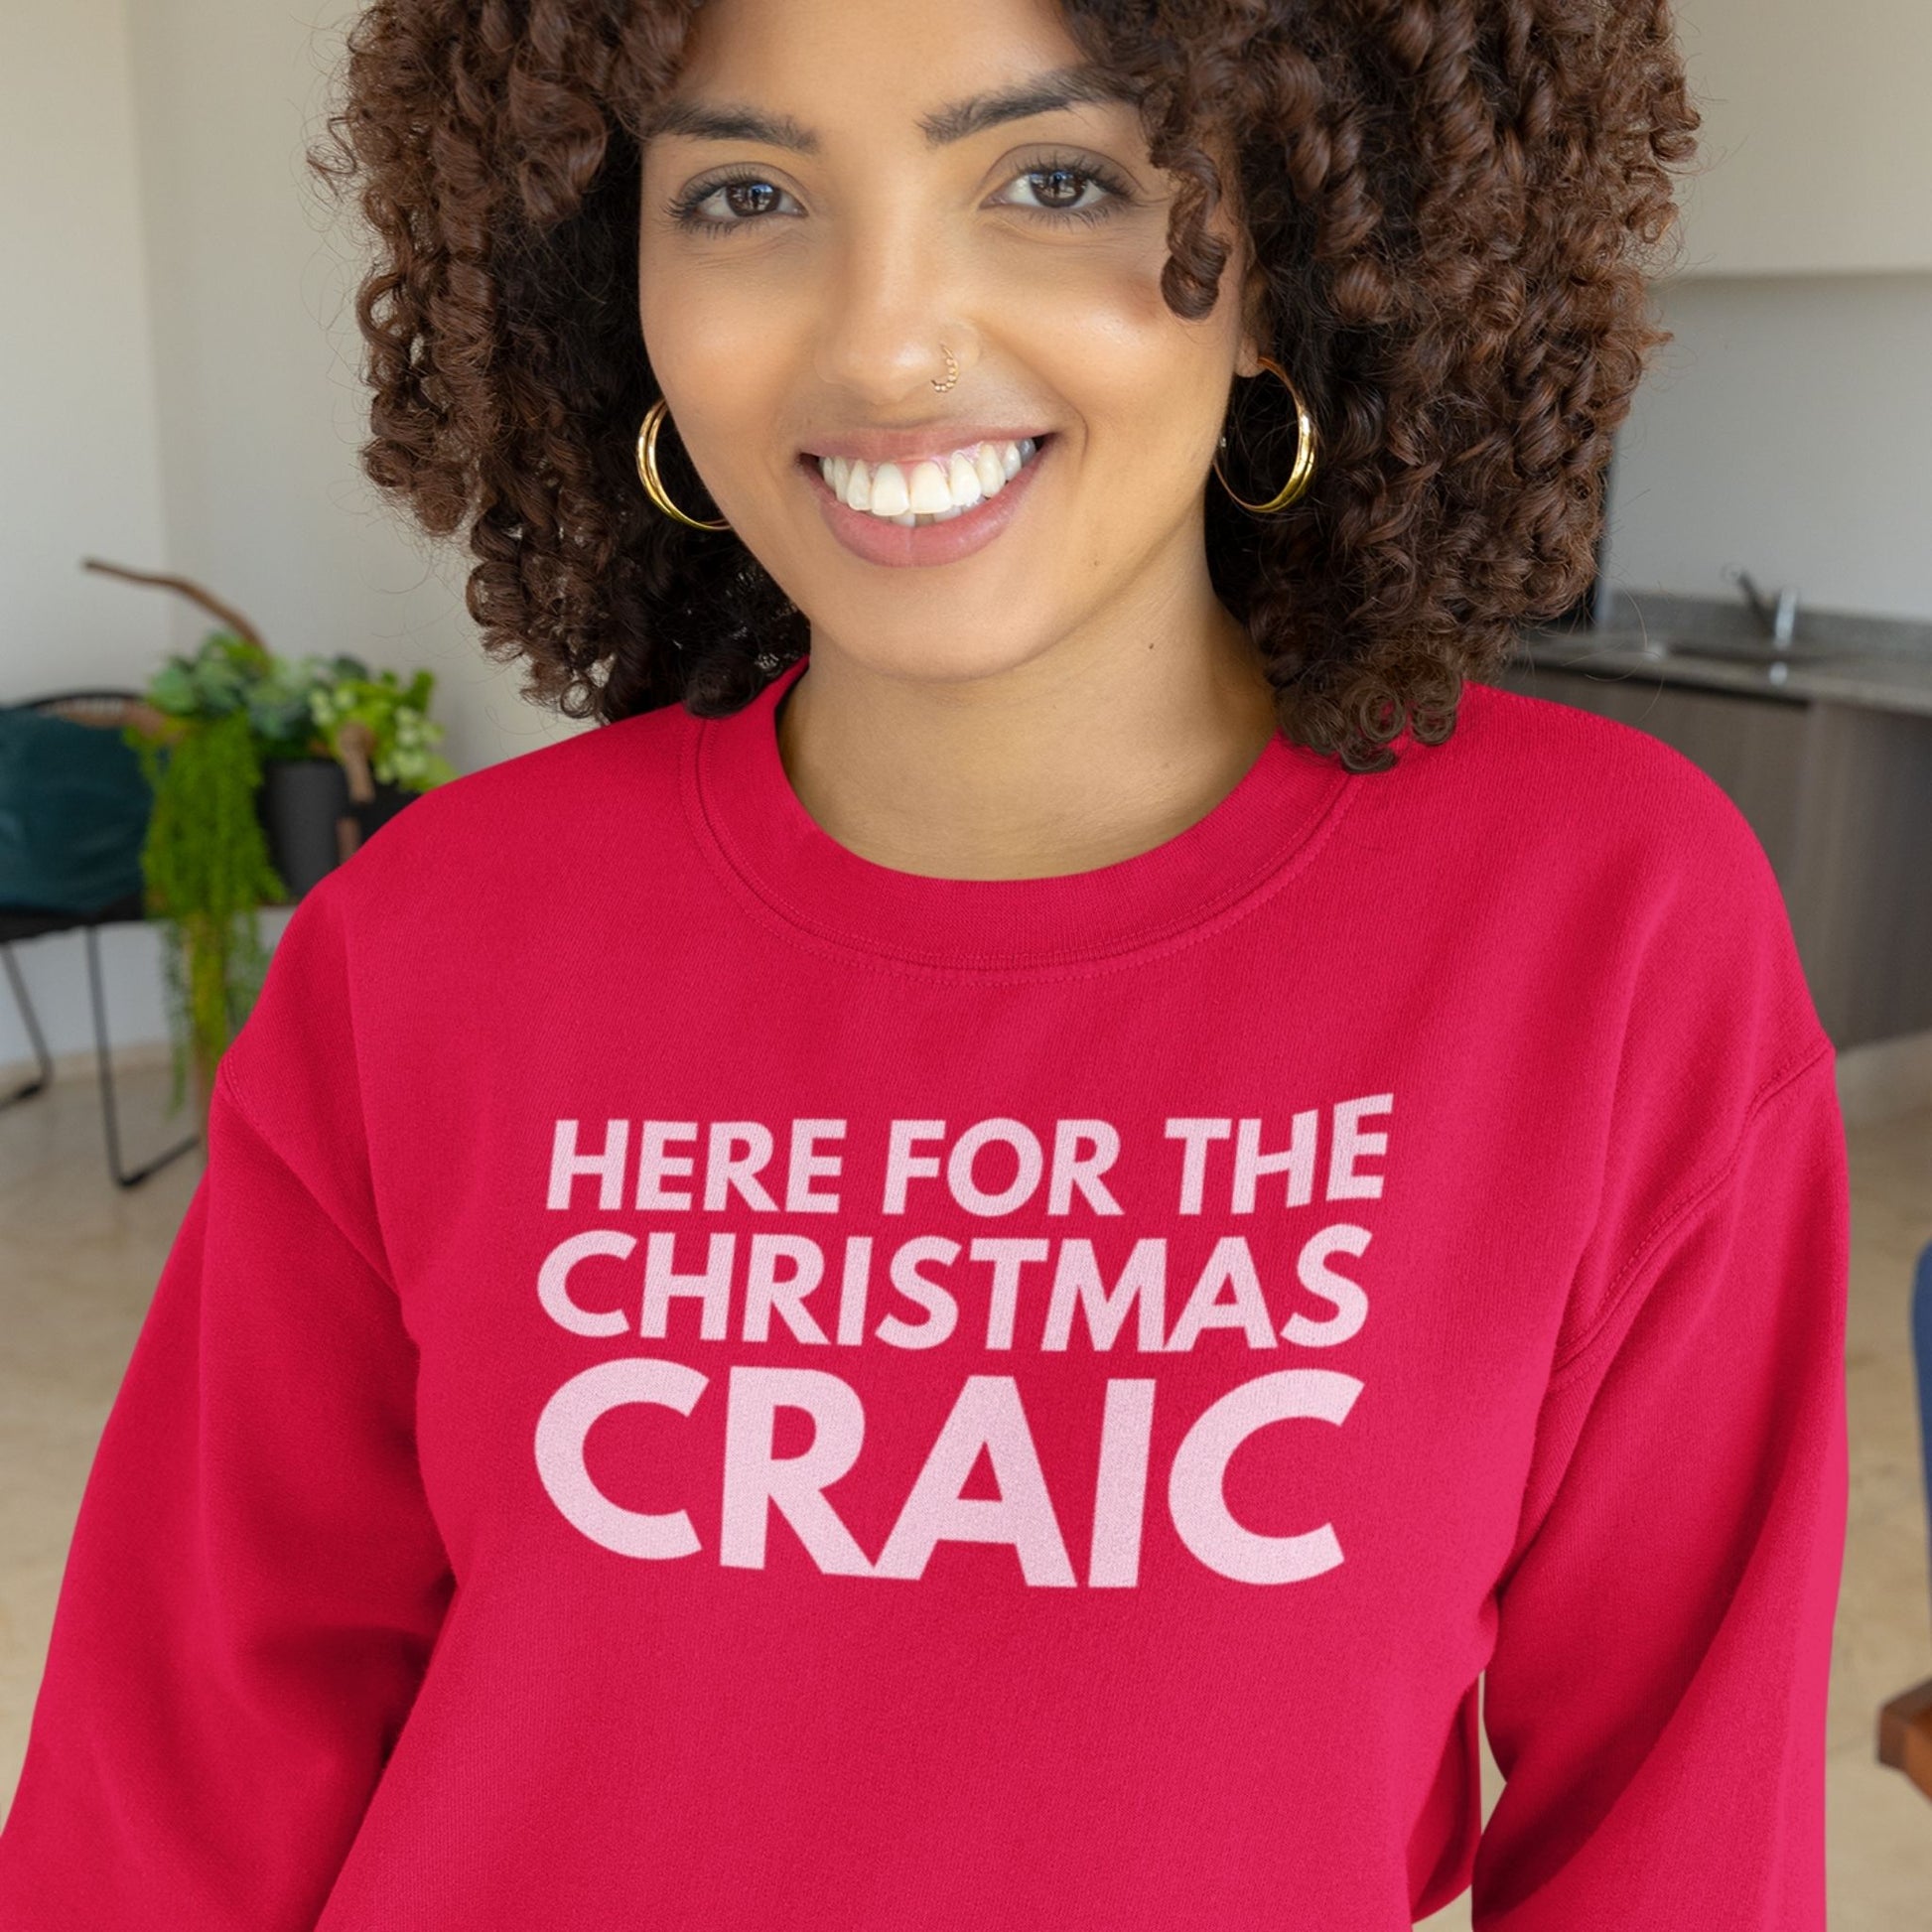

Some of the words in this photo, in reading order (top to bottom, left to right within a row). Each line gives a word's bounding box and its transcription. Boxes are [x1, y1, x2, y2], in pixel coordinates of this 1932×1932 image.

[546, 1118, 847, 1213] HERE
[883, 1117, 1124, 1217] FOR
[1165, 1093, 1394, 1215] THE
[537, 1223, 1373, 1352] CHRISTMAS
[534, 1357, 1365, 1588] CRAIC
